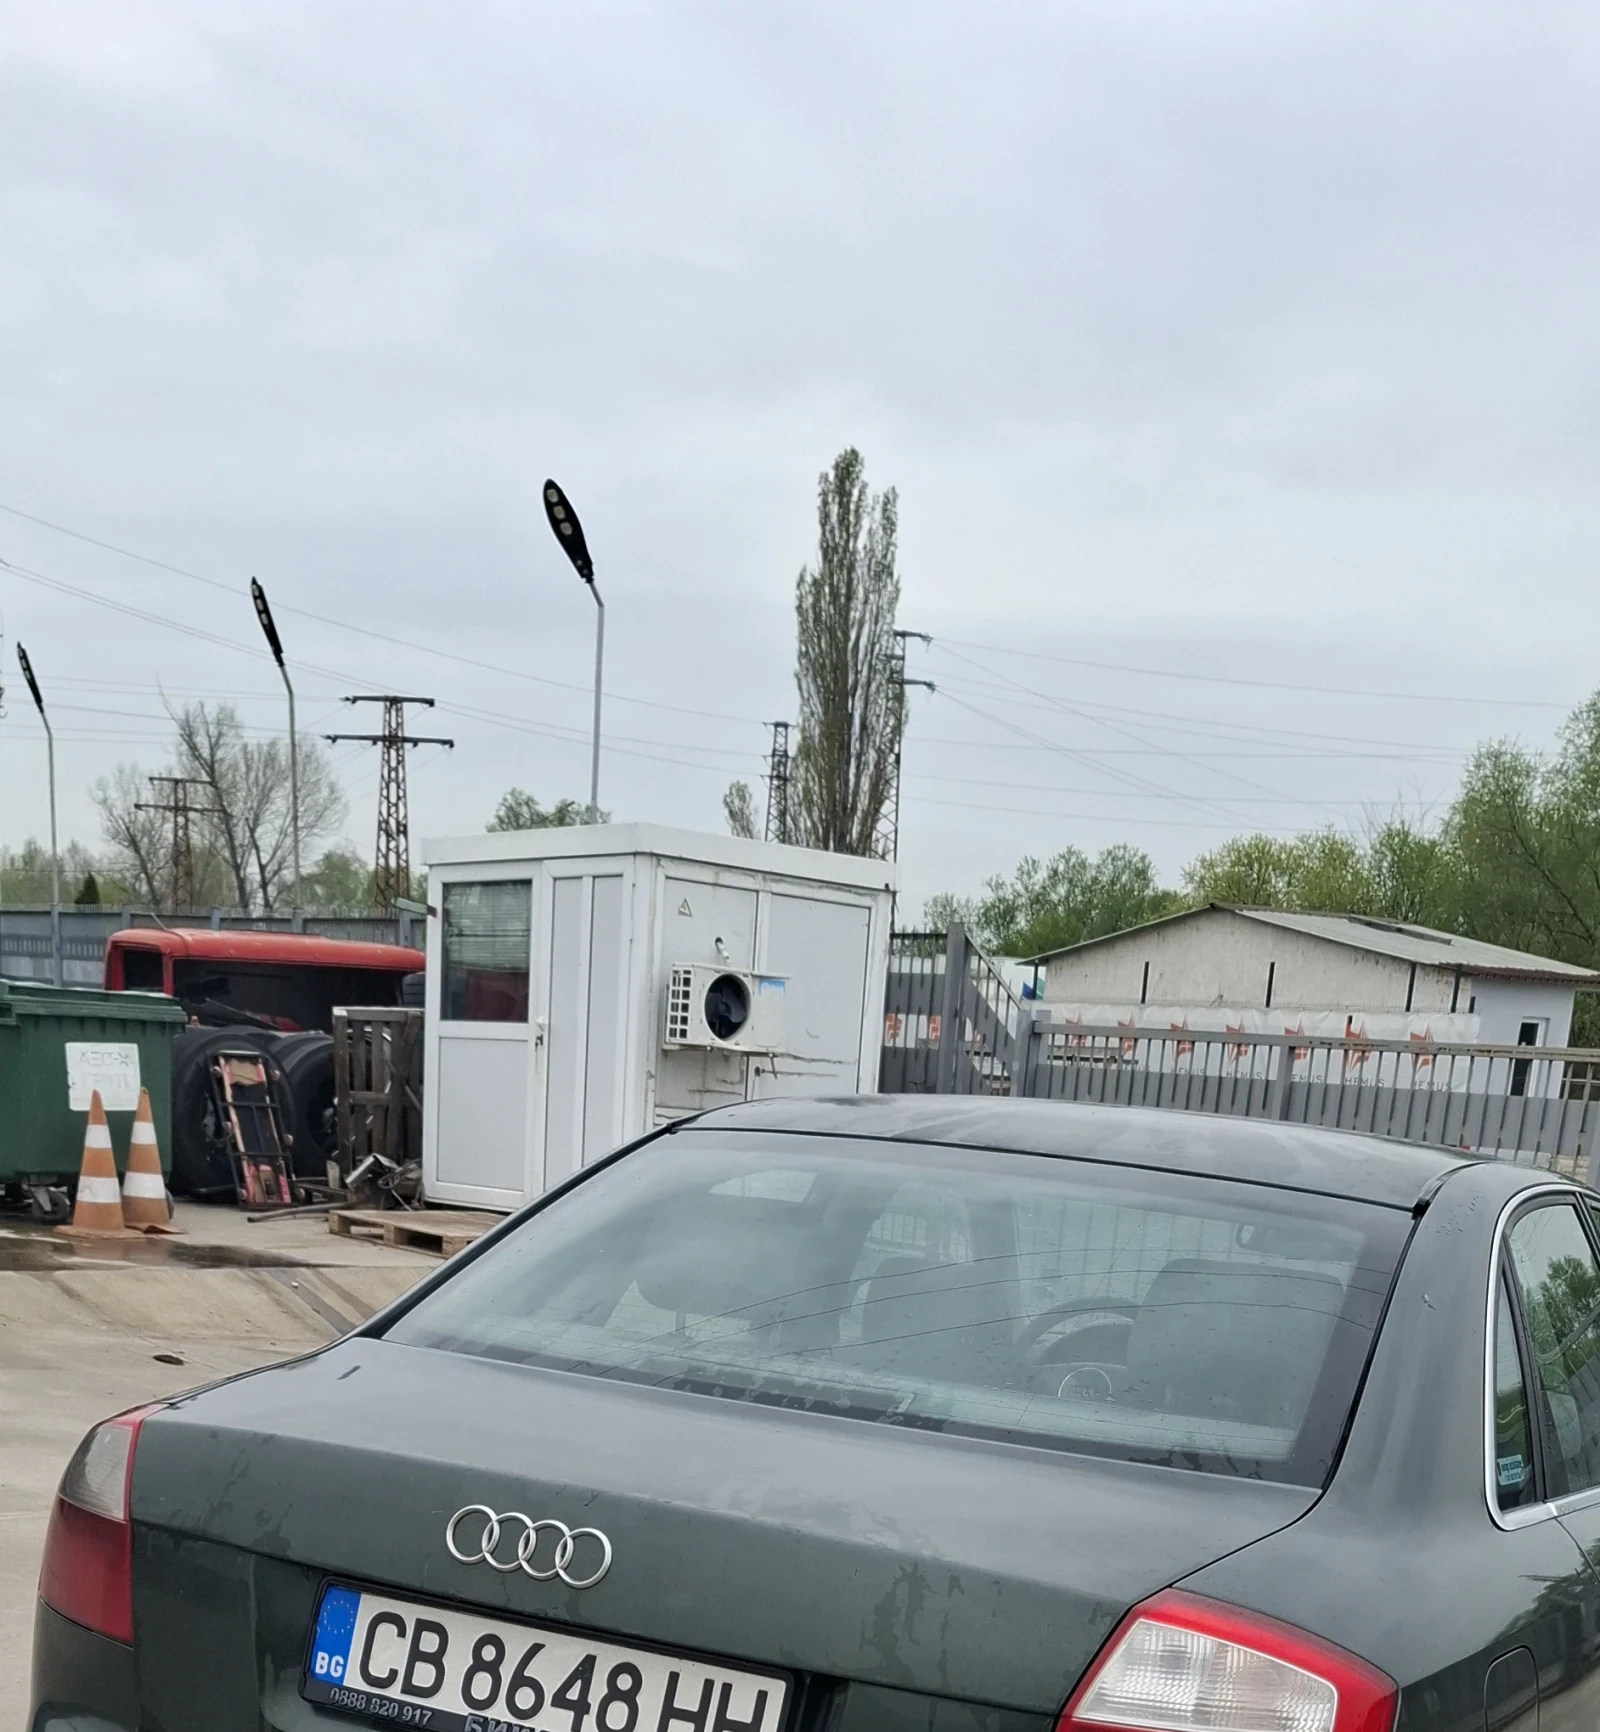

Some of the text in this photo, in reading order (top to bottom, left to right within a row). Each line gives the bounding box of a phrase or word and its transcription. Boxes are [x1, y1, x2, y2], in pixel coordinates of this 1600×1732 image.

[315, 1651, 344, 1678] BG
[359, 1611, 449, 1699] CB
[329, 1687, 433, 1727] 0888 820 917
